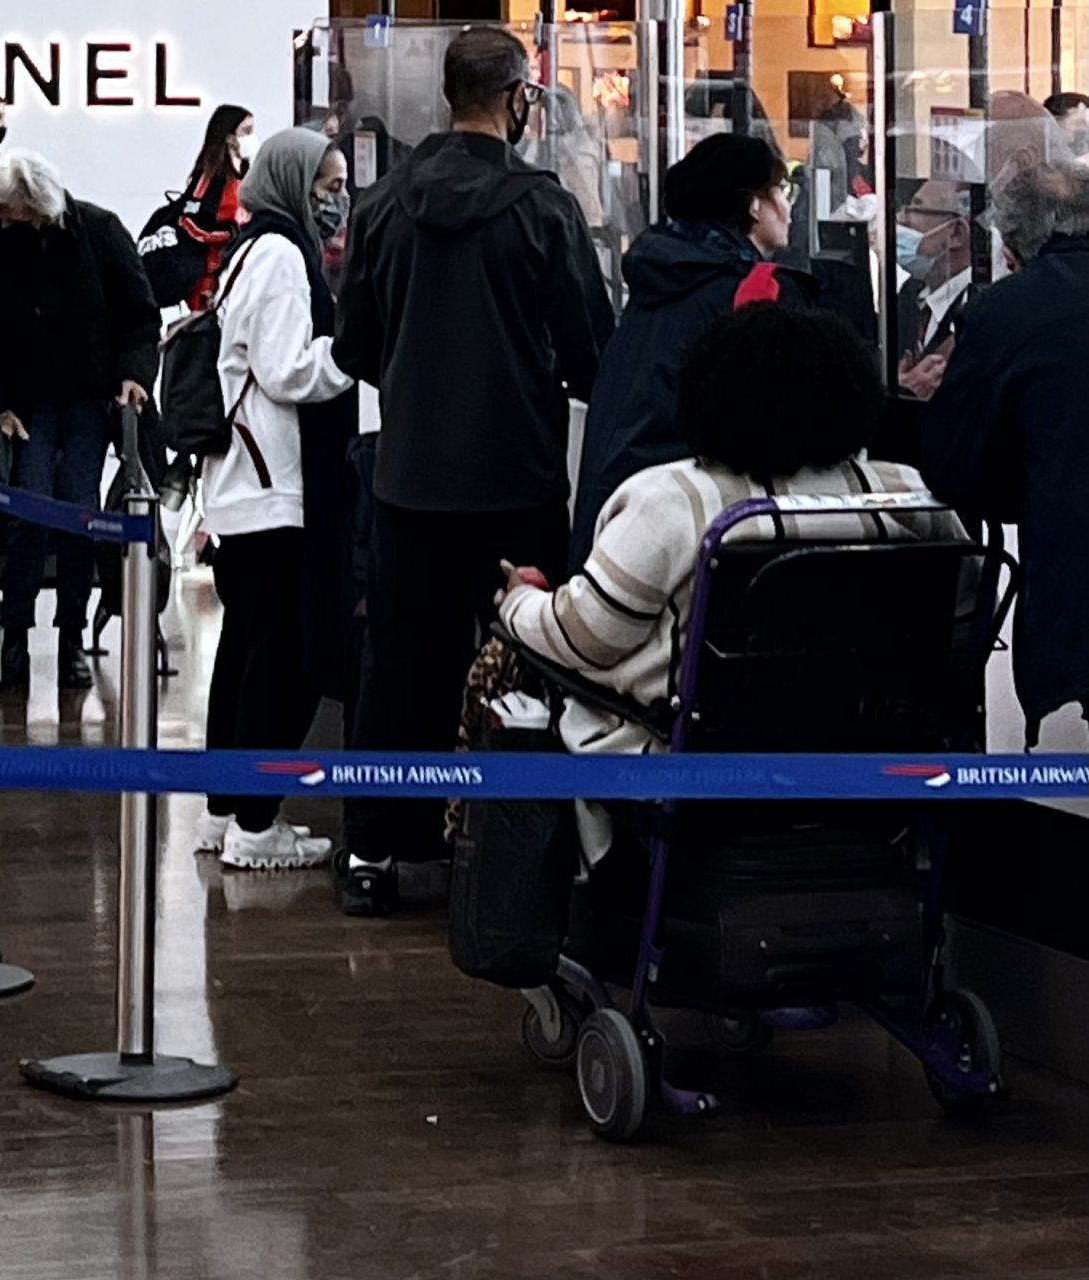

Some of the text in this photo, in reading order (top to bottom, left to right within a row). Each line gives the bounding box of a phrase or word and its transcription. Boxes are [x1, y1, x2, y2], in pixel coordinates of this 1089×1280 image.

[960, 4, 973, 25] 4
[332, 765, 483, 785] BRITISH AIRWAYS
[957, 767, 1089, 784] BRITISH AIRWA
